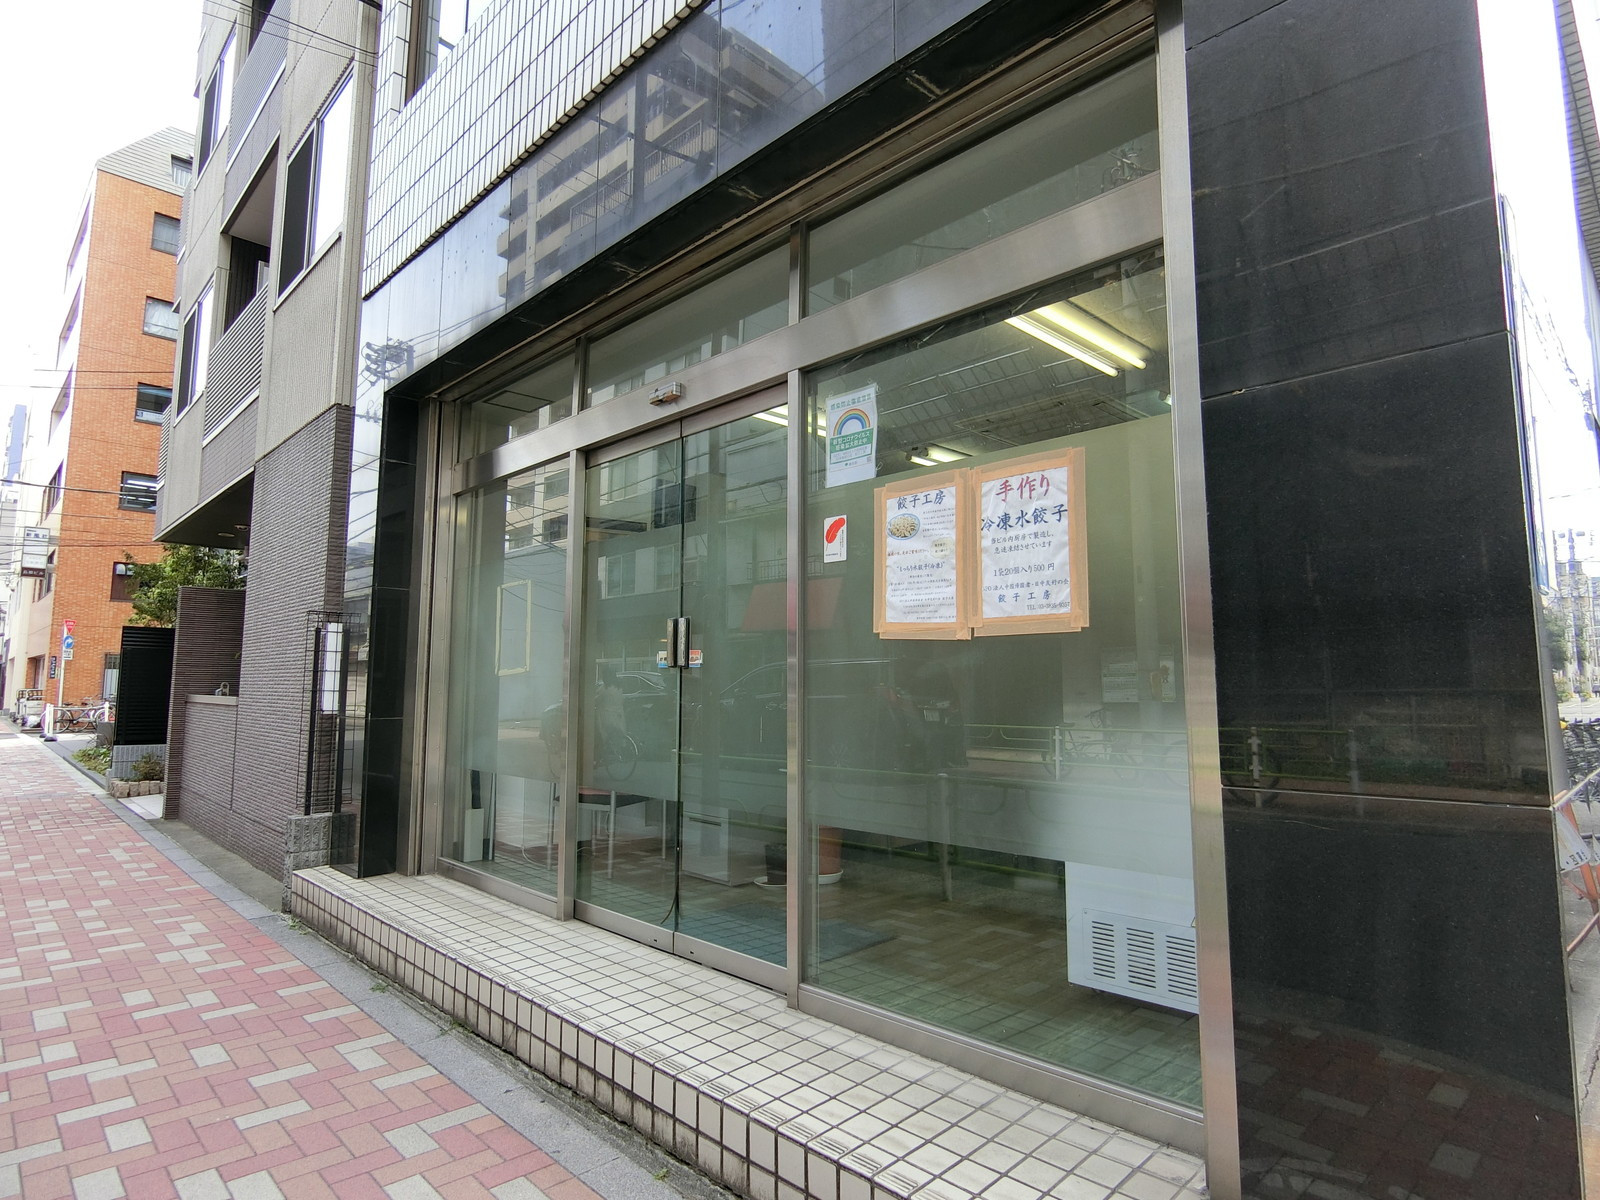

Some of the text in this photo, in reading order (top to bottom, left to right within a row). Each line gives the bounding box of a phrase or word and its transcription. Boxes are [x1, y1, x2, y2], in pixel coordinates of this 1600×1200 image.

[897, 490, 946, 510] 餃子工房
[995, 473, 1050, 503] 手作り
[980, 504, 1068, 533] 冷凍水餃子
